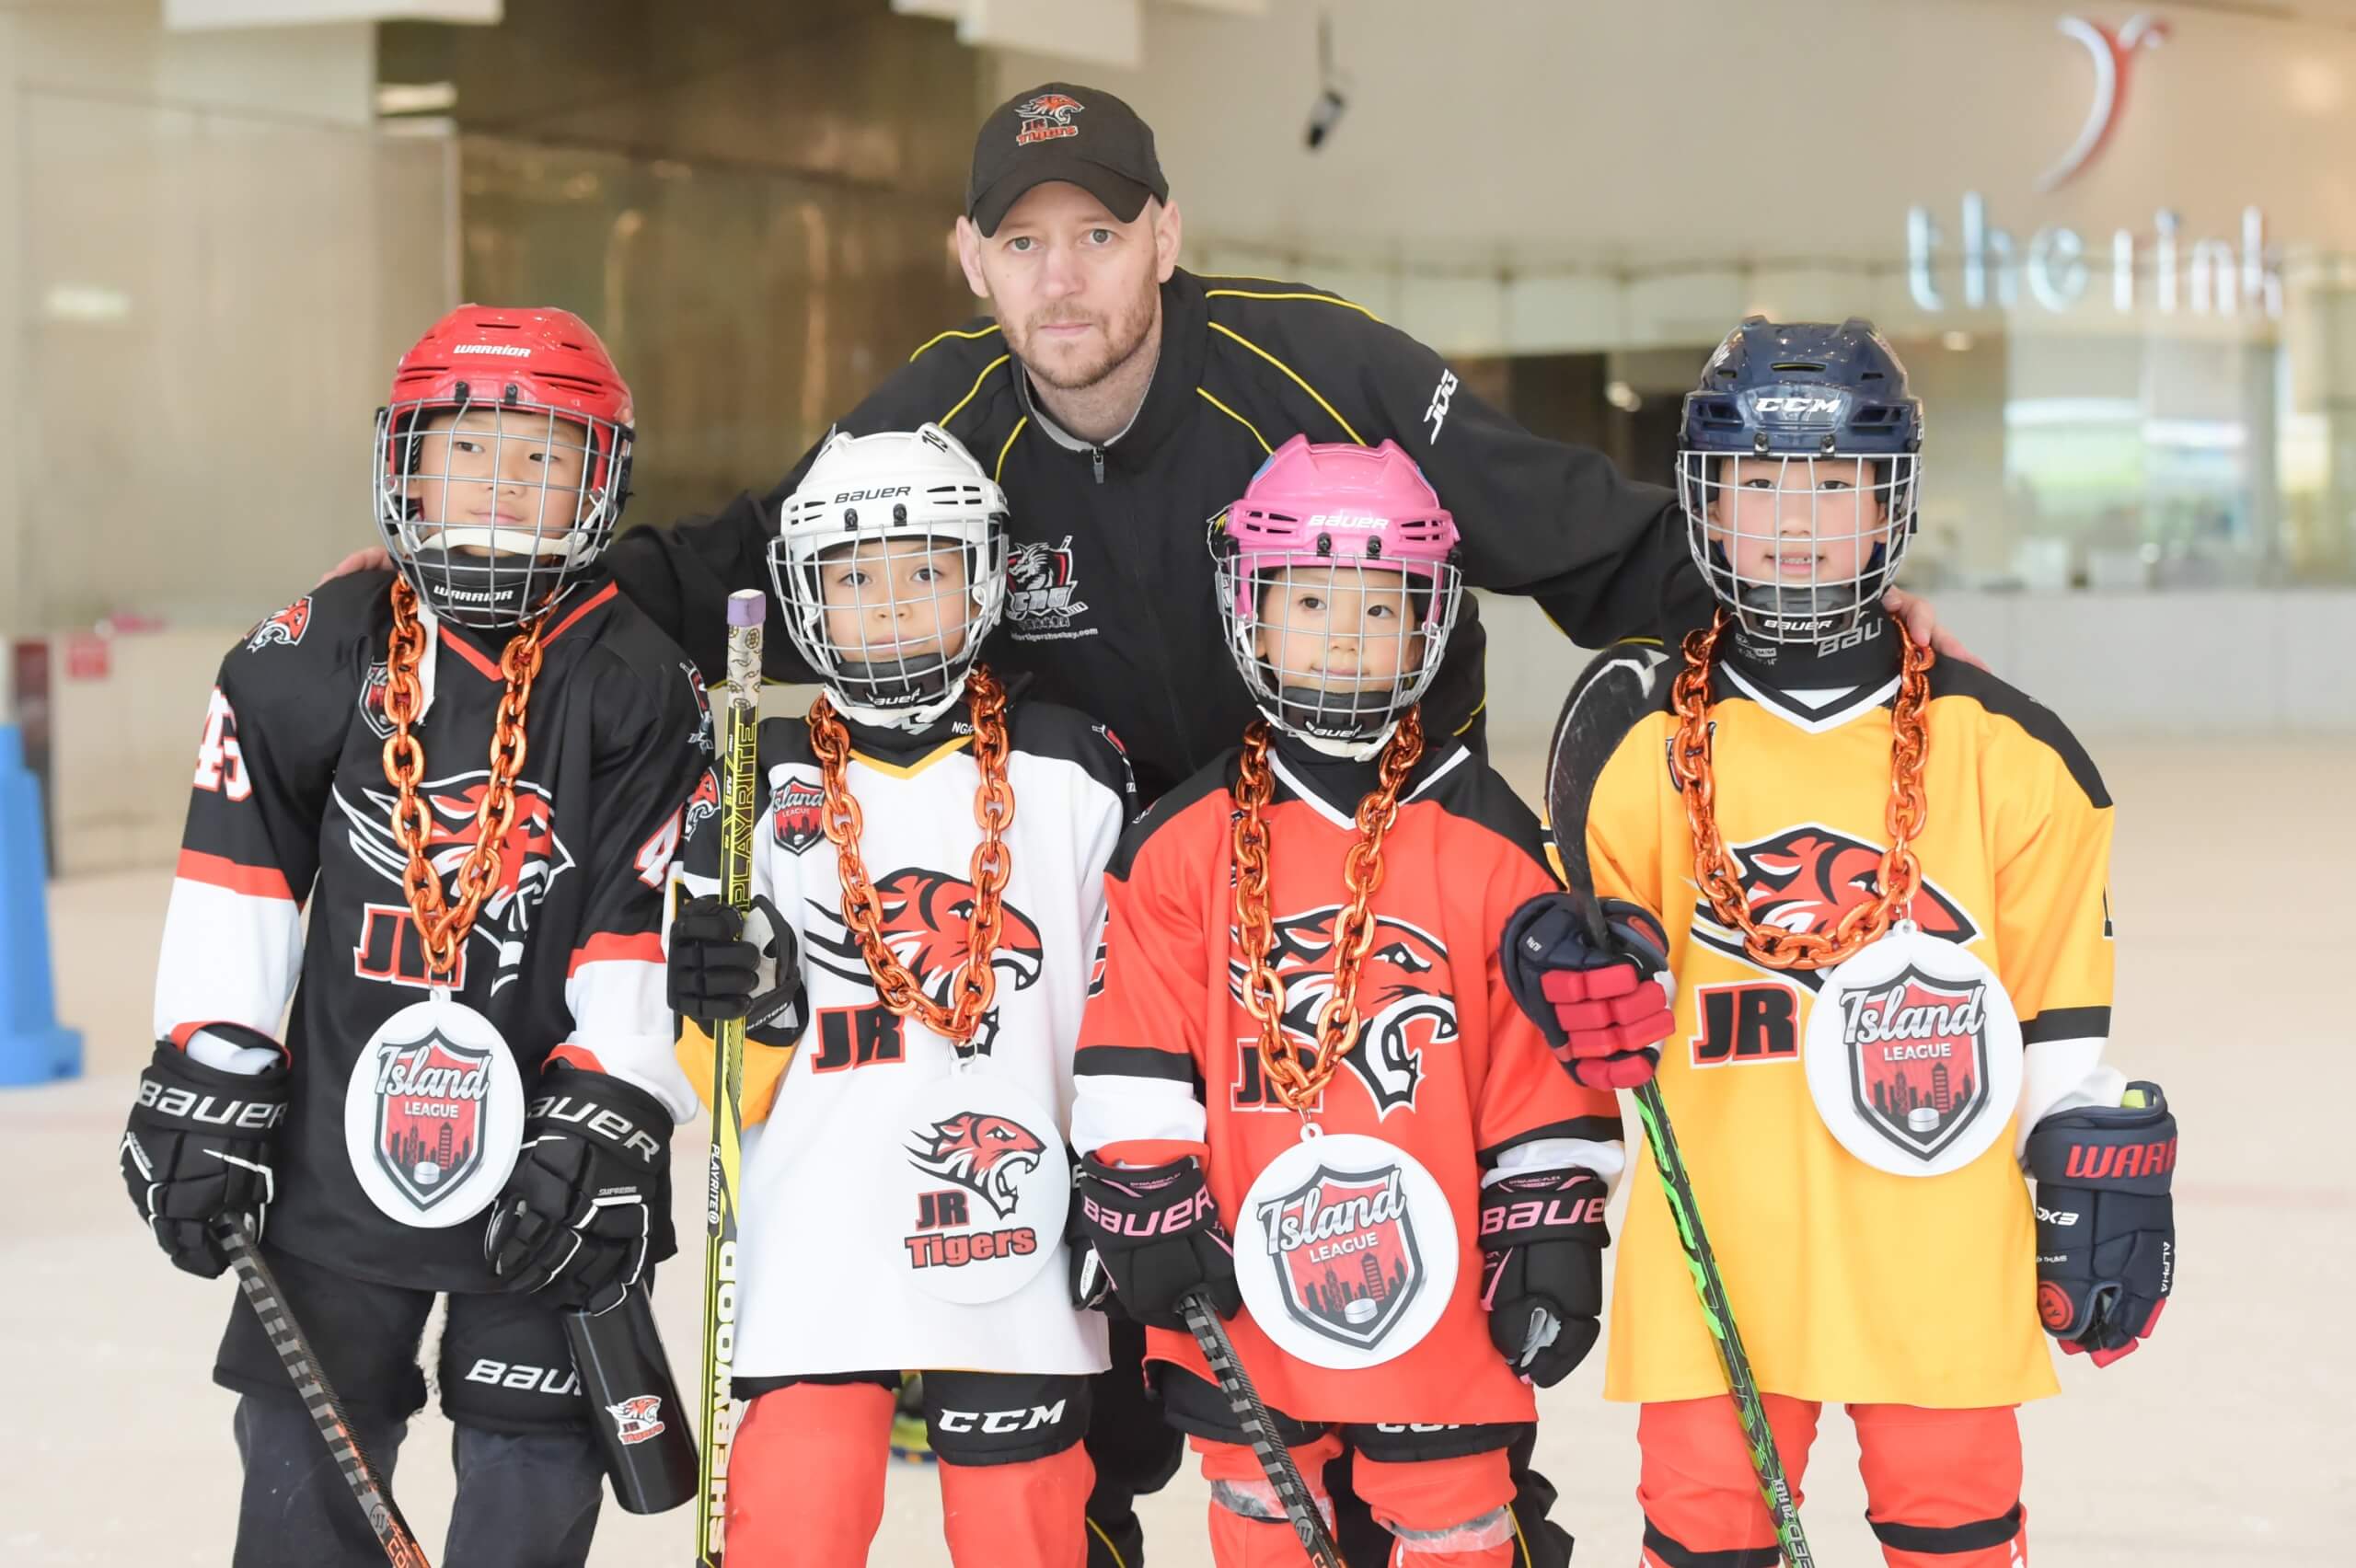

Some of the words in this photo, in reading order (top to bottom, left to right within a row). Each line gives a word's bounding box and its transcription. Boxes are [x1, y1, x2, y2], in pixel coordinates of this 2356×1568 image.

[1908, 190, 2089, 313] the
[1755, 398, 1841, 412] CCM
[734, 722, 756, 909] PLAYRITE
[811, 1001, 906, 1074] JR
[1691, 981, 1799, 1066] JR
[1840, 985, 1986, 1045] Island
[376, 1045, 494, 1101] Island
[1883, 1042, 1952, 1061] LEAGUE
[404, 1101, 459, 1119] LEAGUE
[528, 1095, 660, 1163] AUER
[708, 1143, 721, 1211] PLAYRITE
[914, 1190, 970, 1231] JR
[1257, 1168, 1405, 1256] Island
[904, 1226, 1036, 1269] Tigers
[1310, 1231, 1379, 1264] LEAGUE
[2160, 1241, 2171, 1293] ALPHA
[939, 1399, 1066, 1434] CCM
